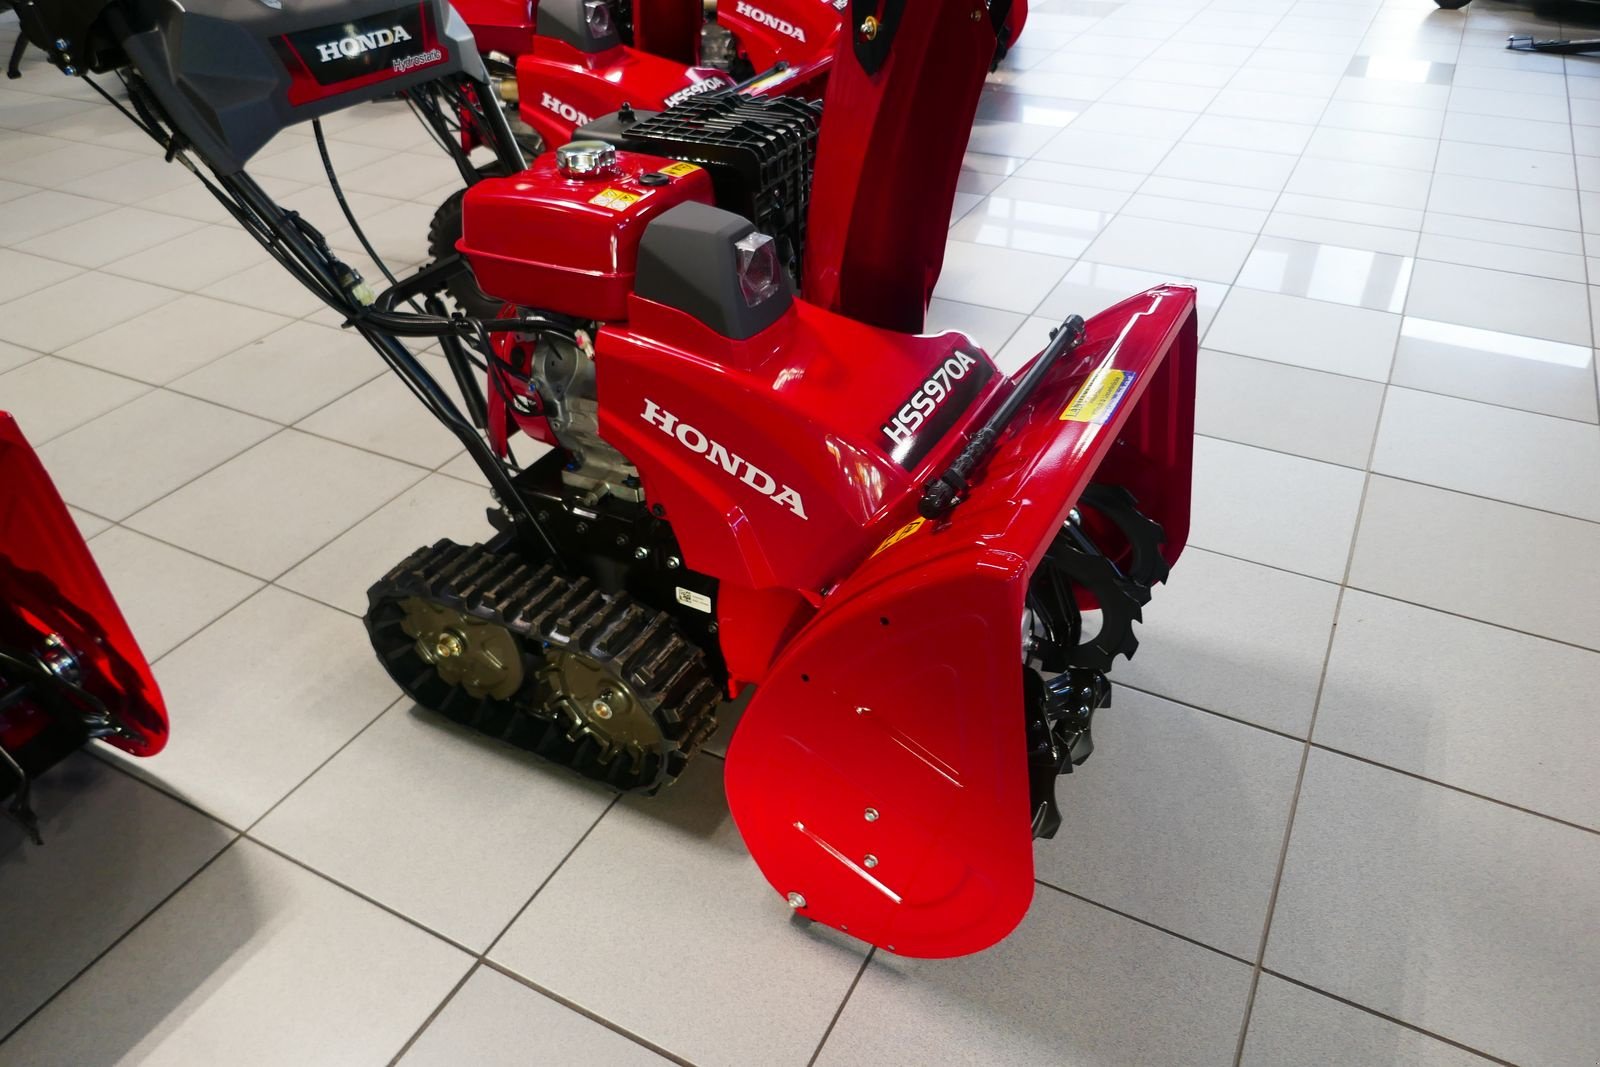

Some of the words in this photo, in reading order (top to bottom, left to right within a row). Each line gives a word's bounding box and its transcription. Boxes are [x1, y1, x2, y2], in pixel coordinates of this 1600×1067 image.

[736, 1, 806, 43] HONDA
[316, 25, 412, 62] HONDA
[392, 48, 442, 72] Hydrostatic
[882, 349, 976, 446] HSS970A
[640, 398, 809, 520] HONDA
